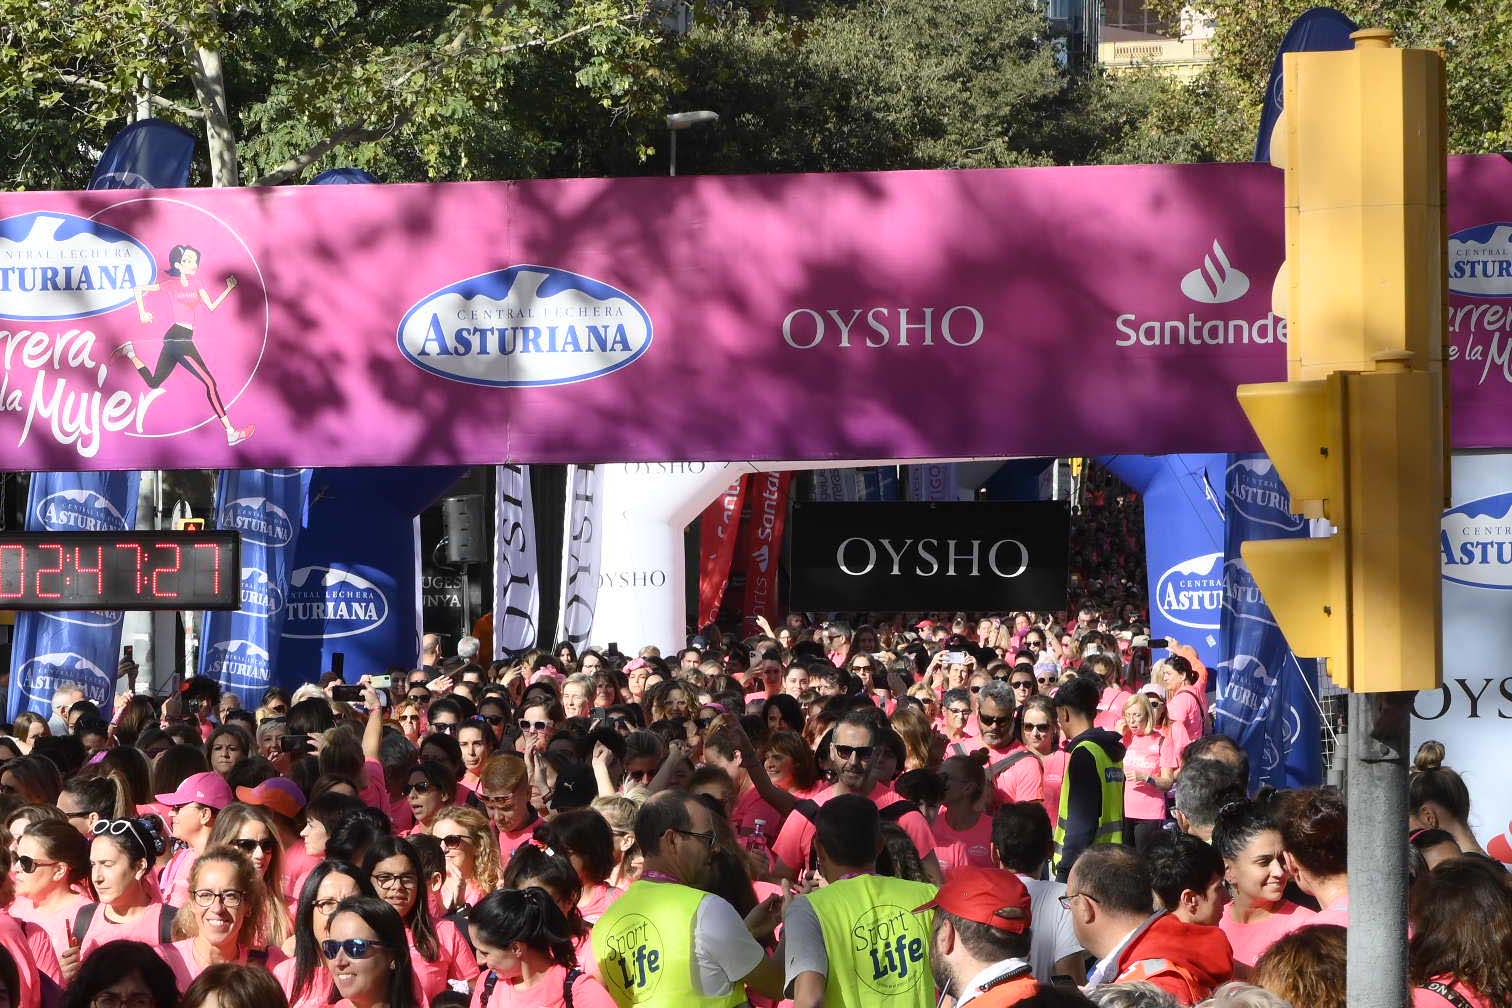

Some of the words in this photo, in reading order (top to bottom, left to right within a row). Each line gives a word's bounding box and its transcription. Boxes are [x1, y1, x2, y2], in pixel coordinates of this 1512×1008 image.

[417, 311, 633, 359] ASTURIANA
[456, 306, 536, 322] CENTRAL
[781, 305, 985, 350] OYSHO
[1115, 311, 1287, 347] Santande
[18, 364, 167, 458] Mujer
[501, 463, 537, 655] OYSH
[564, 464, 596, 644] OYSH
[836, 535, 1029, 579] OYSHO
[325, 590, 375, 600] LECHERA
[1179, 579, 1221, 589] CENTRA
[285, 601, 379, 621] TURIANA
[606, 919, 649, 961] Sport
[853, 909, 910, 952] Sport
[618, 944, 661, 990] Life
[869, 933, 925, 981] Life
